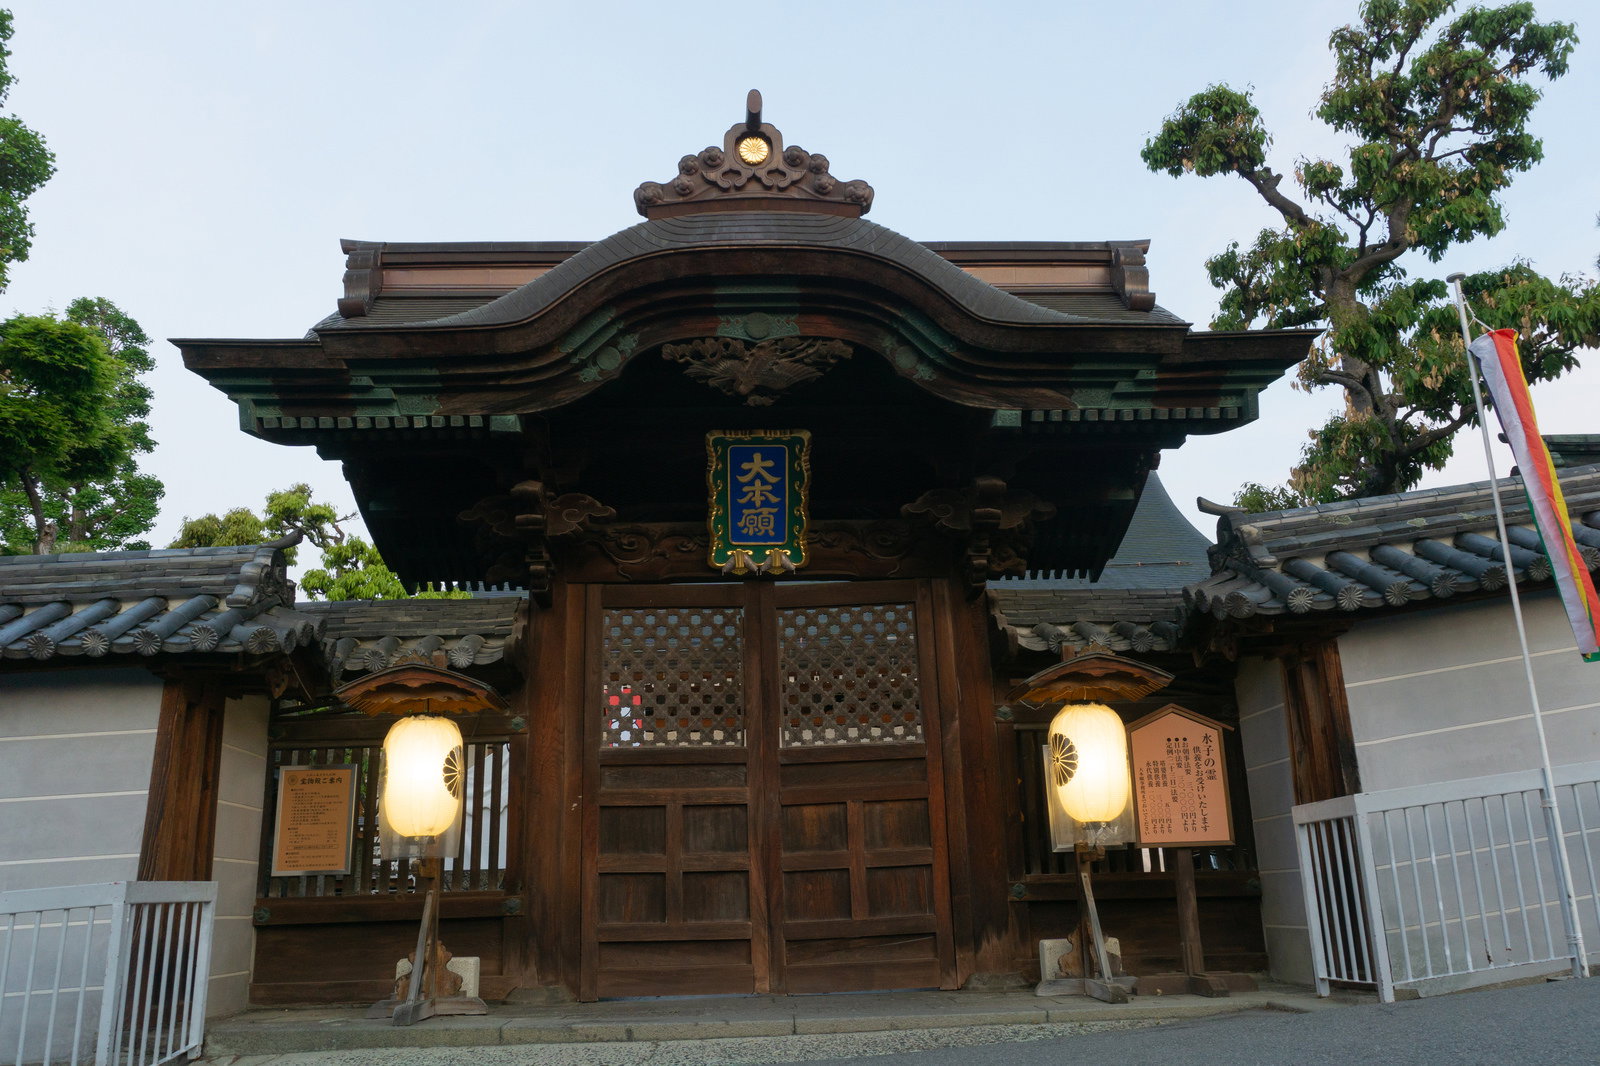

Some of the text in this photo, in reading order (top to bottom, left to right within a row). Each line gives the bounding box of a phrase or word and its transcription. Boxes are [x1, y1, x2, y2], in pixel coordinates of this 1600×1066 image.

[736, 453, 781, 536] 大本願
[1193, 746, 1210, 832] 供養をお受けいたします
